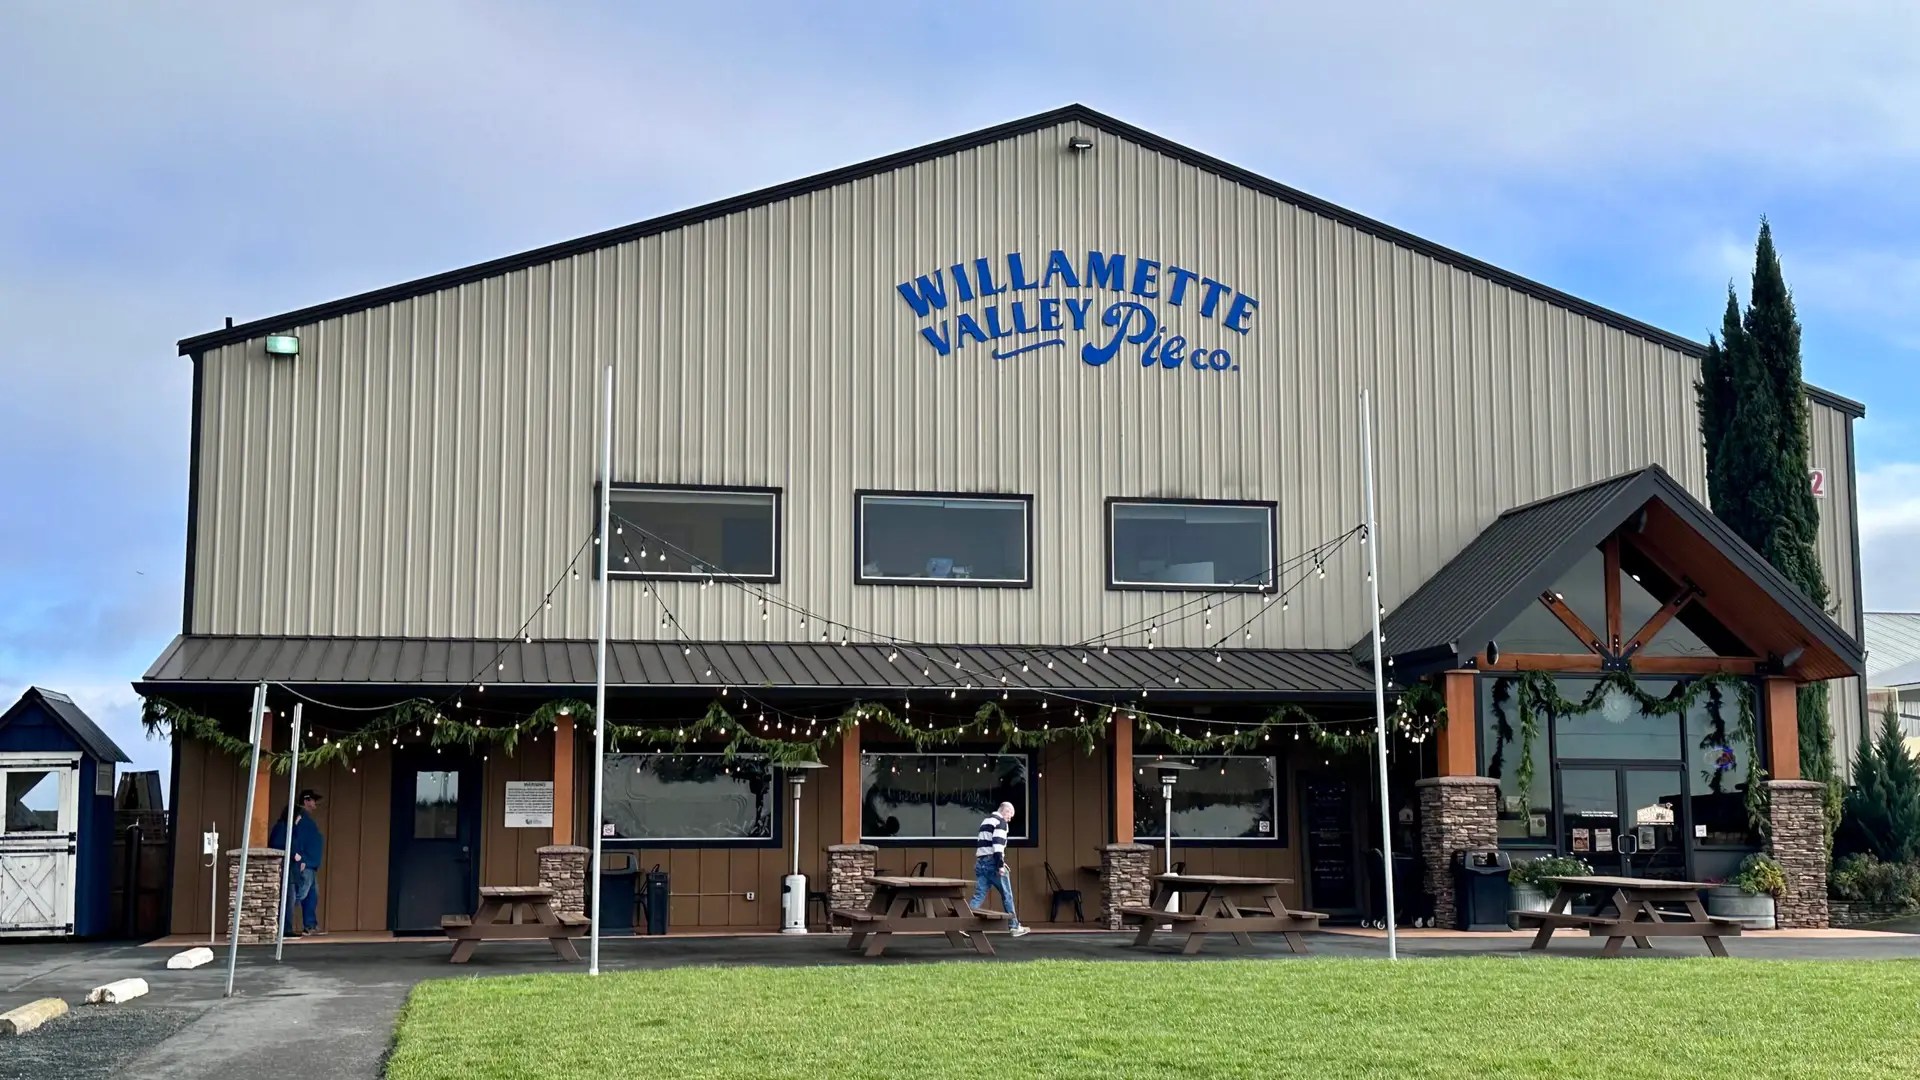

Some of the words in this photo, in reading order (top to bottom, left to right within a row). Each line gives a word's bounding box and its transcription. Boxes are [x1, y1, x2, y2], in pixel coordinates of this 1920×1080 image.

[896, 250, 1260, 335] WILLAMETTE
[921, 298, 1093, 357] VALLEY
[1081, 301, 1187, 368] Pie
[1809, 471, 1823, 494] 2
